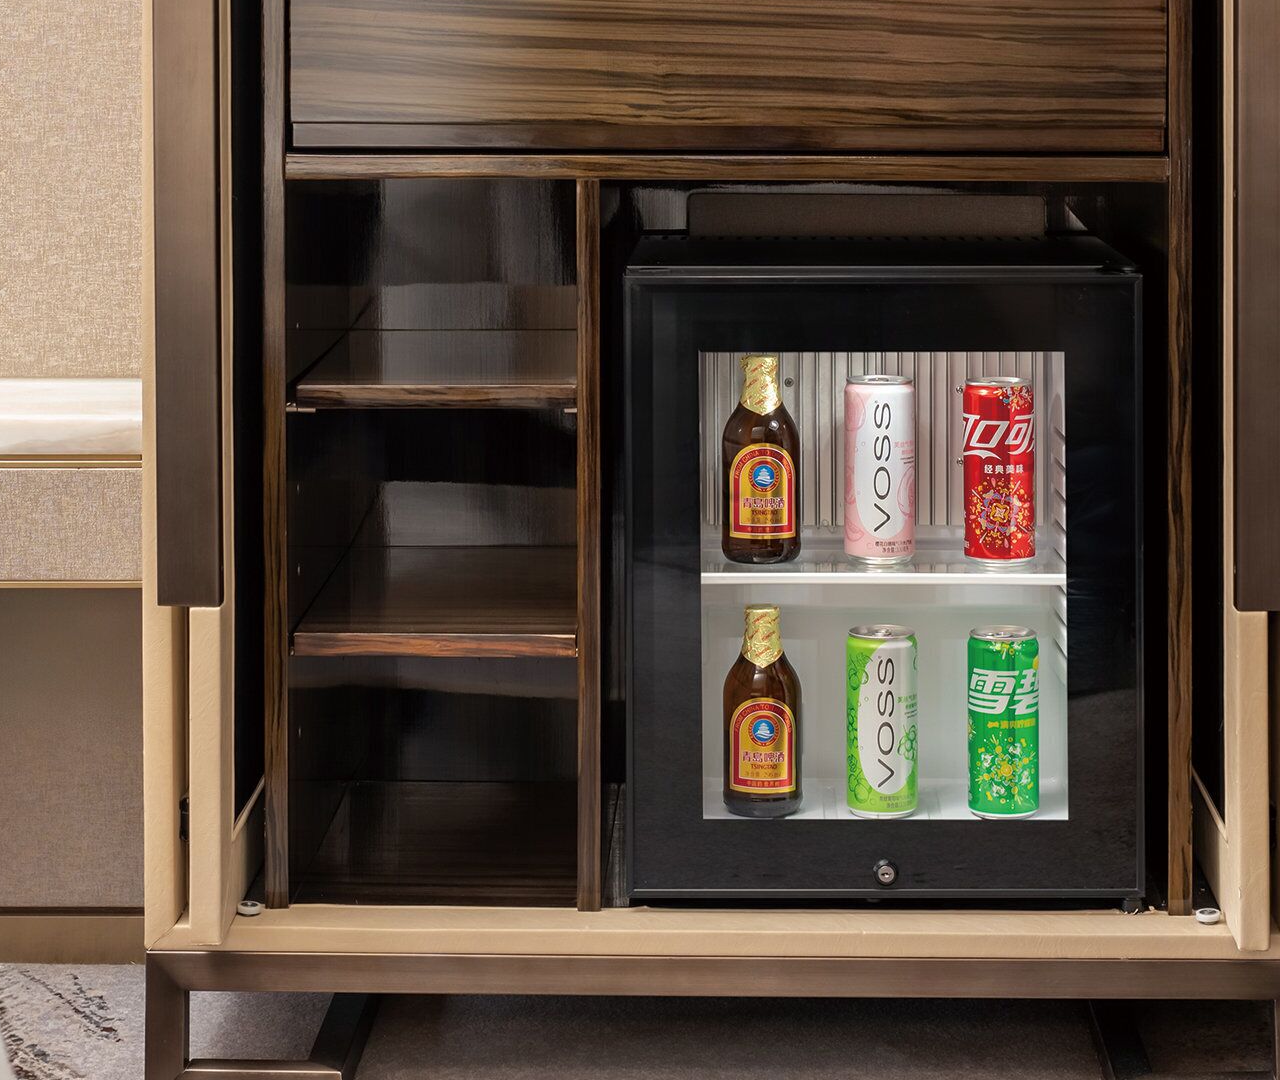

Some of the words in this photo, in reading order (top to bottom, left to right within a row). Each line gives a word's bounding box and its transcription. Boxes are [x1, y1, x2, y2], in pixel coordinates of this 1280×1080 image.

[874, 402, 891, 532] VOSS
[984, 464, 1024, 474] 经典美味
[877, 657, 895, 788] VOSS
